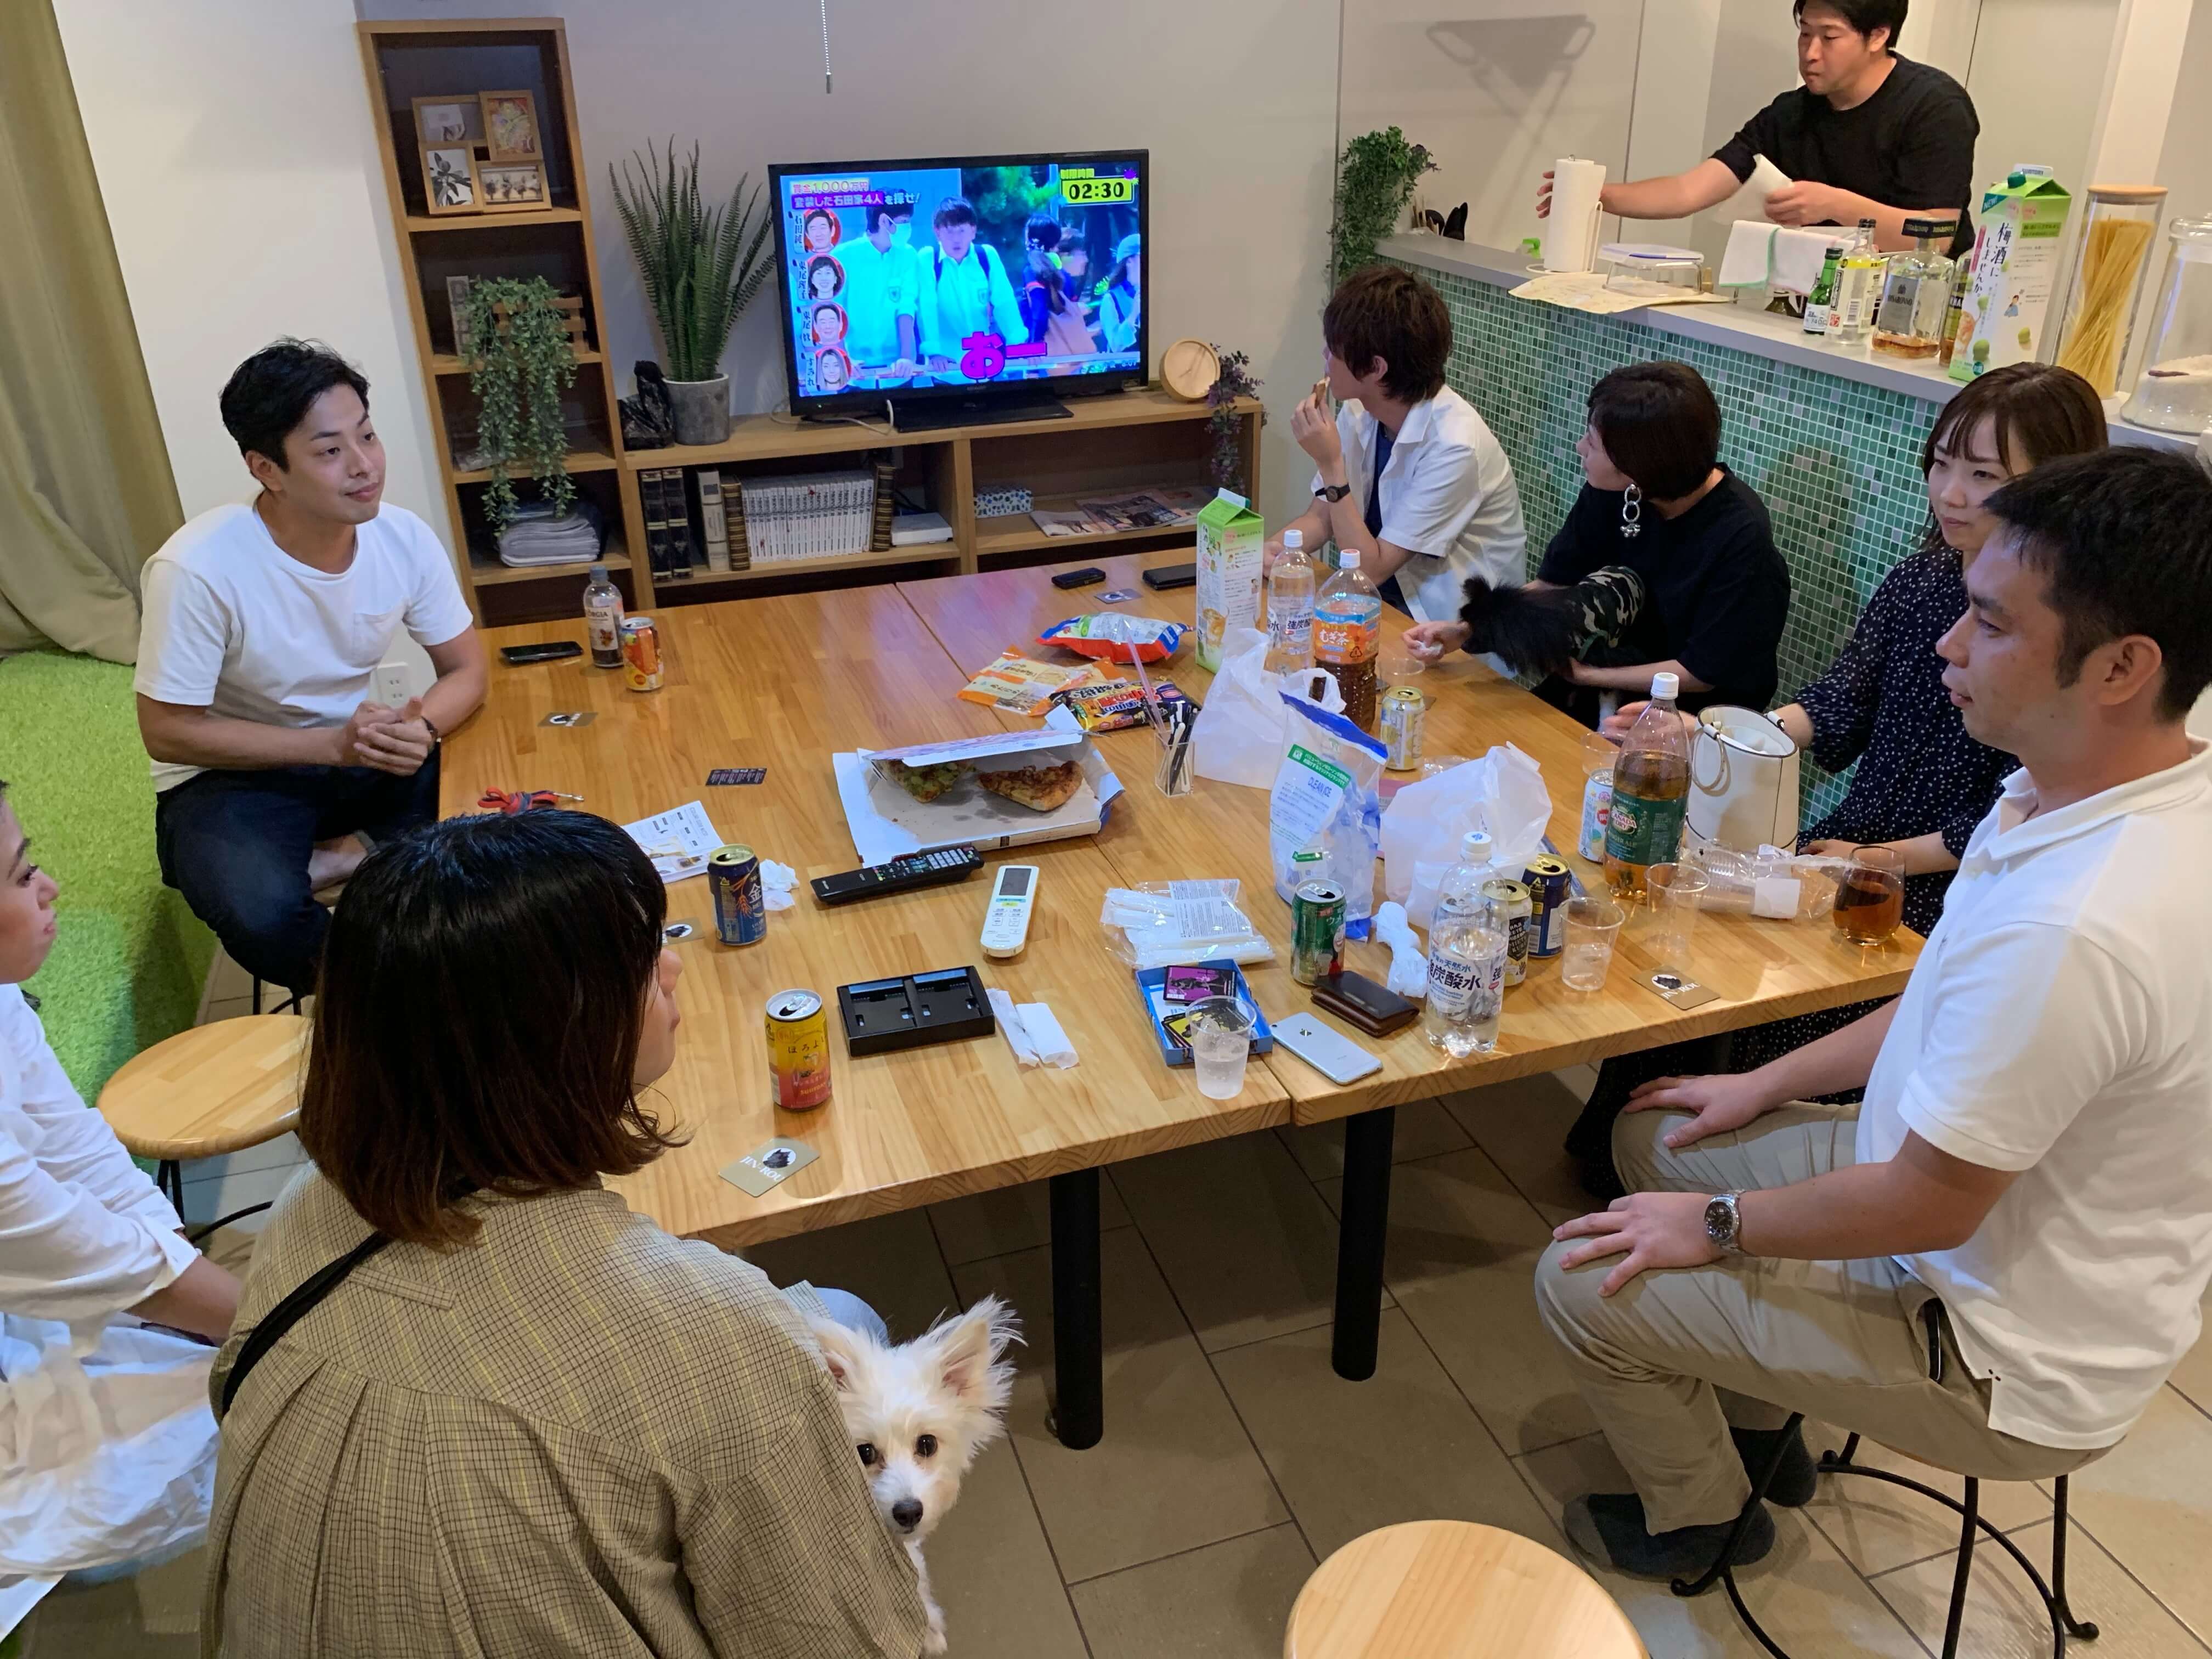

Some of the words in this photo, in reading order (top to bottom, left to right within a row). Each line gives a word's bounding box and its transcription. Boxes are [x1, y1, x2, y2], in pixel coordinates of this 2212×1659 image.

[1069, 182, 1124, 199] 02:30
[1319, 629, 1350, 646] むぎ茶
[1611, 811, 1637, 828] CANADA
[1615, 820, 1627, 830] DRY
